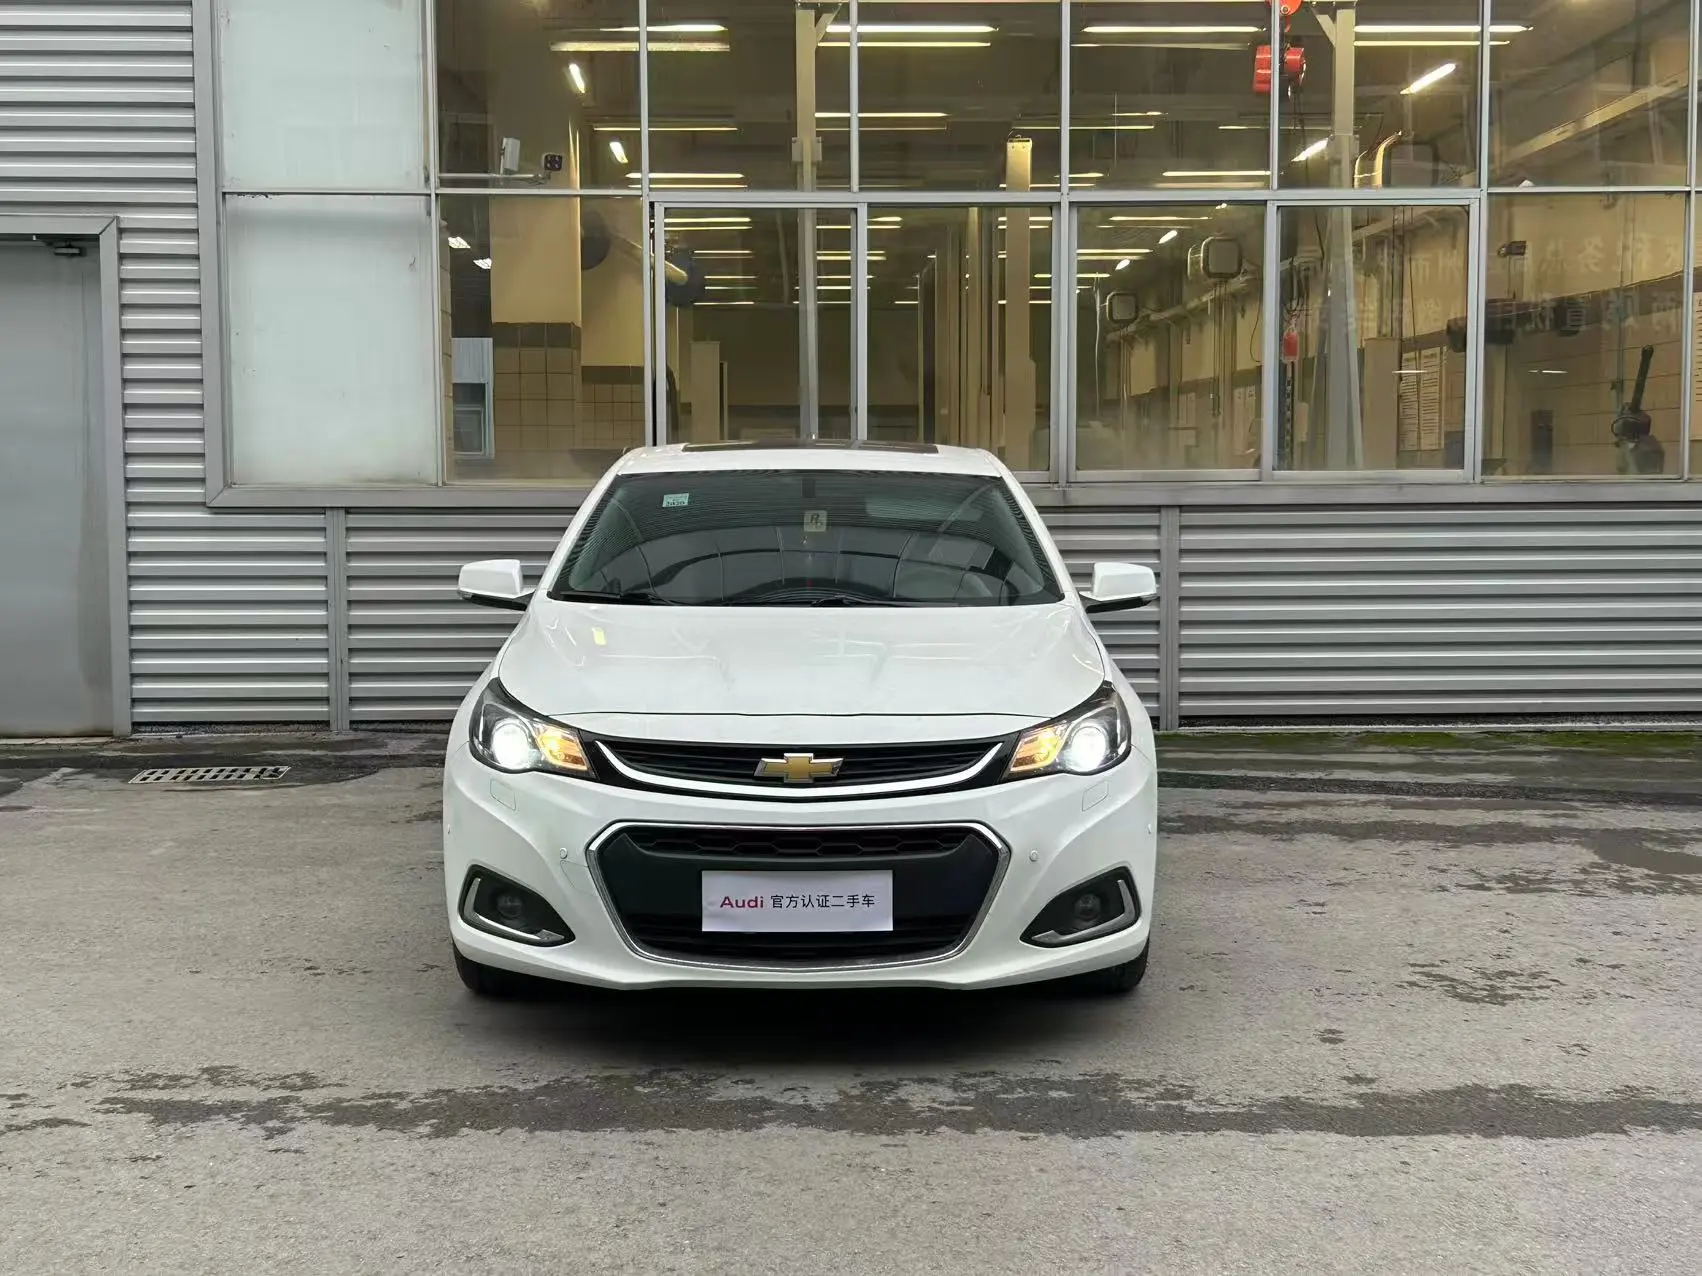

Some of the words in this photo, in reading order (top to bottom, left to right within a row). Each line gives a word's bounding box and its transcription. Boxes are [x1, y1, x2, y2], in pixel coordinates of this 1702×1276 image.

[720, 896, 764, 908] Audi
[770, 894, 875, 909] 官方认证二手车
